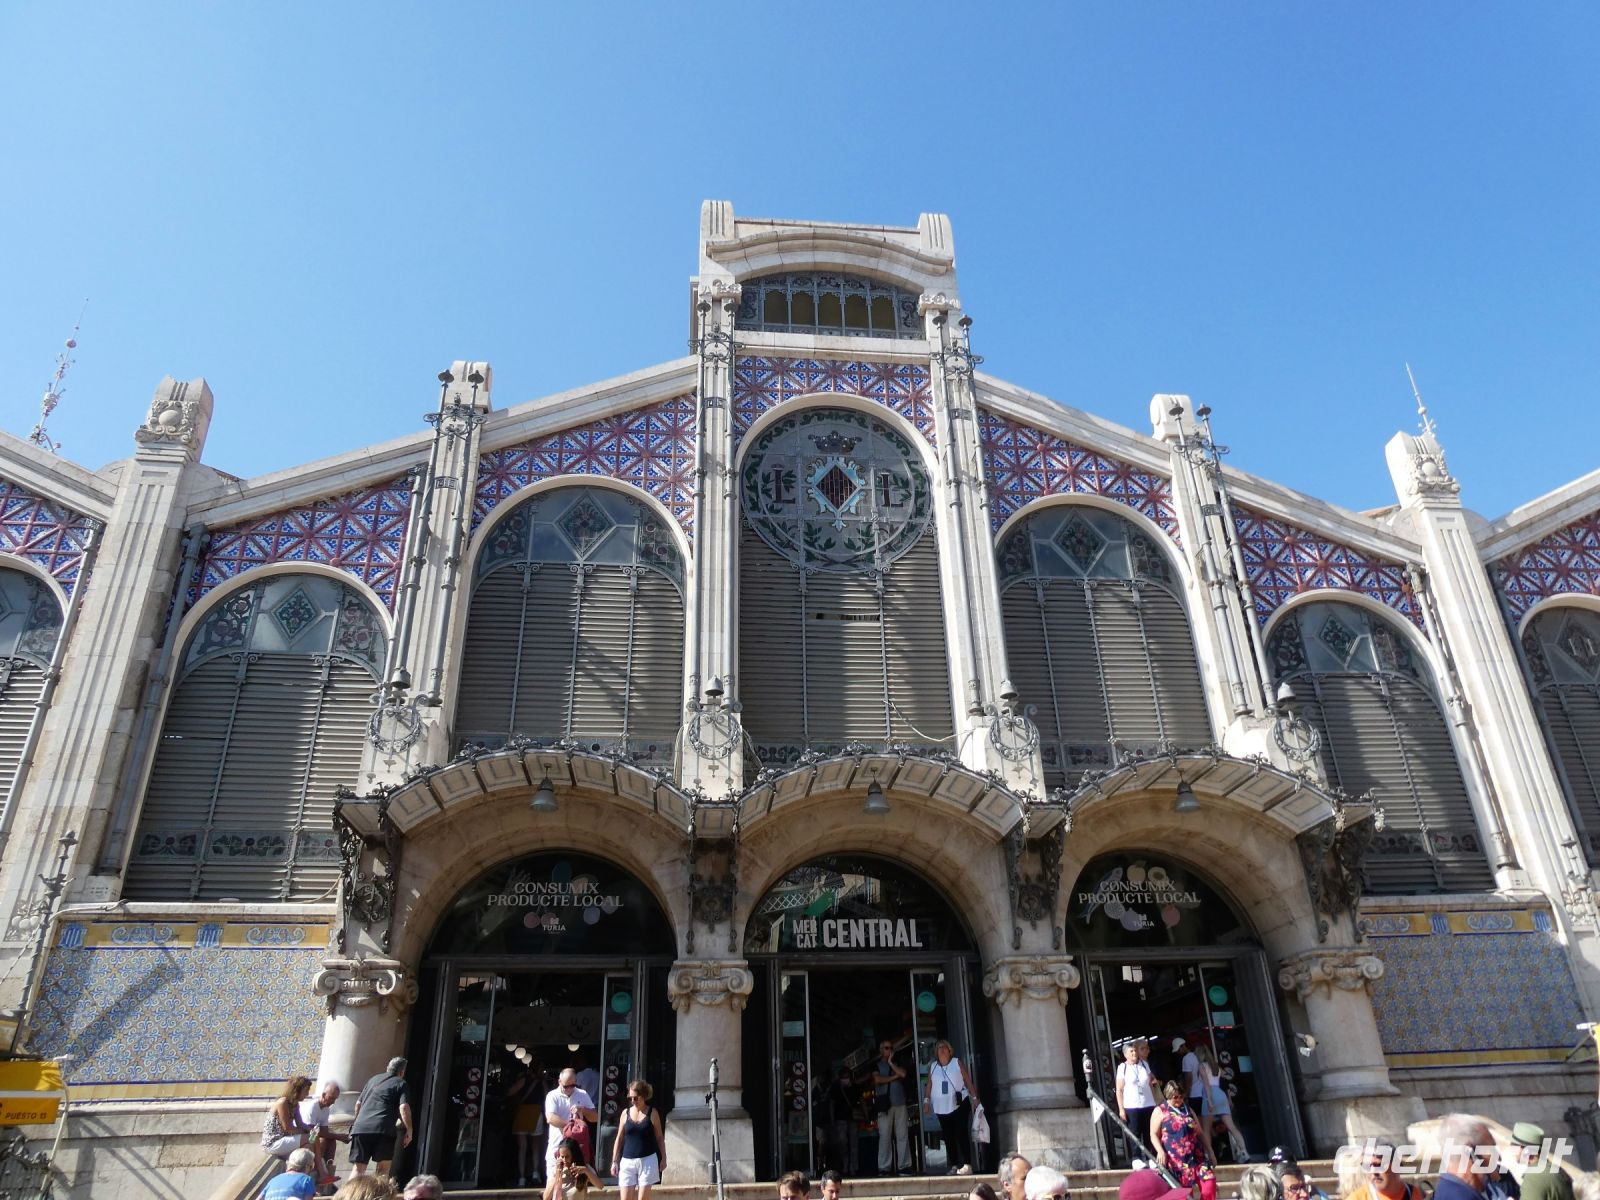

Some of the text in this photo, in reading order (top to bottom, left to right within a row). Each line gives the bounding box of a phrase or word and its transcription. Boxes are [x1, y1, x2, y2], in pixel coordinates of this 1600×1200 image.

[514, 881, 600, 894] CONSUMIX
[1099, 880, 1176, 892] CONSUMIX
[487, 894, 624, 907] PRODUCTE LOCAL
[1078, 891, 1201, 904] PRODUCTE LOCAL
[793, 919, 818, 934] MER
[823, 919, 923, 948] CENTRAL
[796, 934, 818, 948] CAT
[5, 1112, 37, 1120] PUESTO
